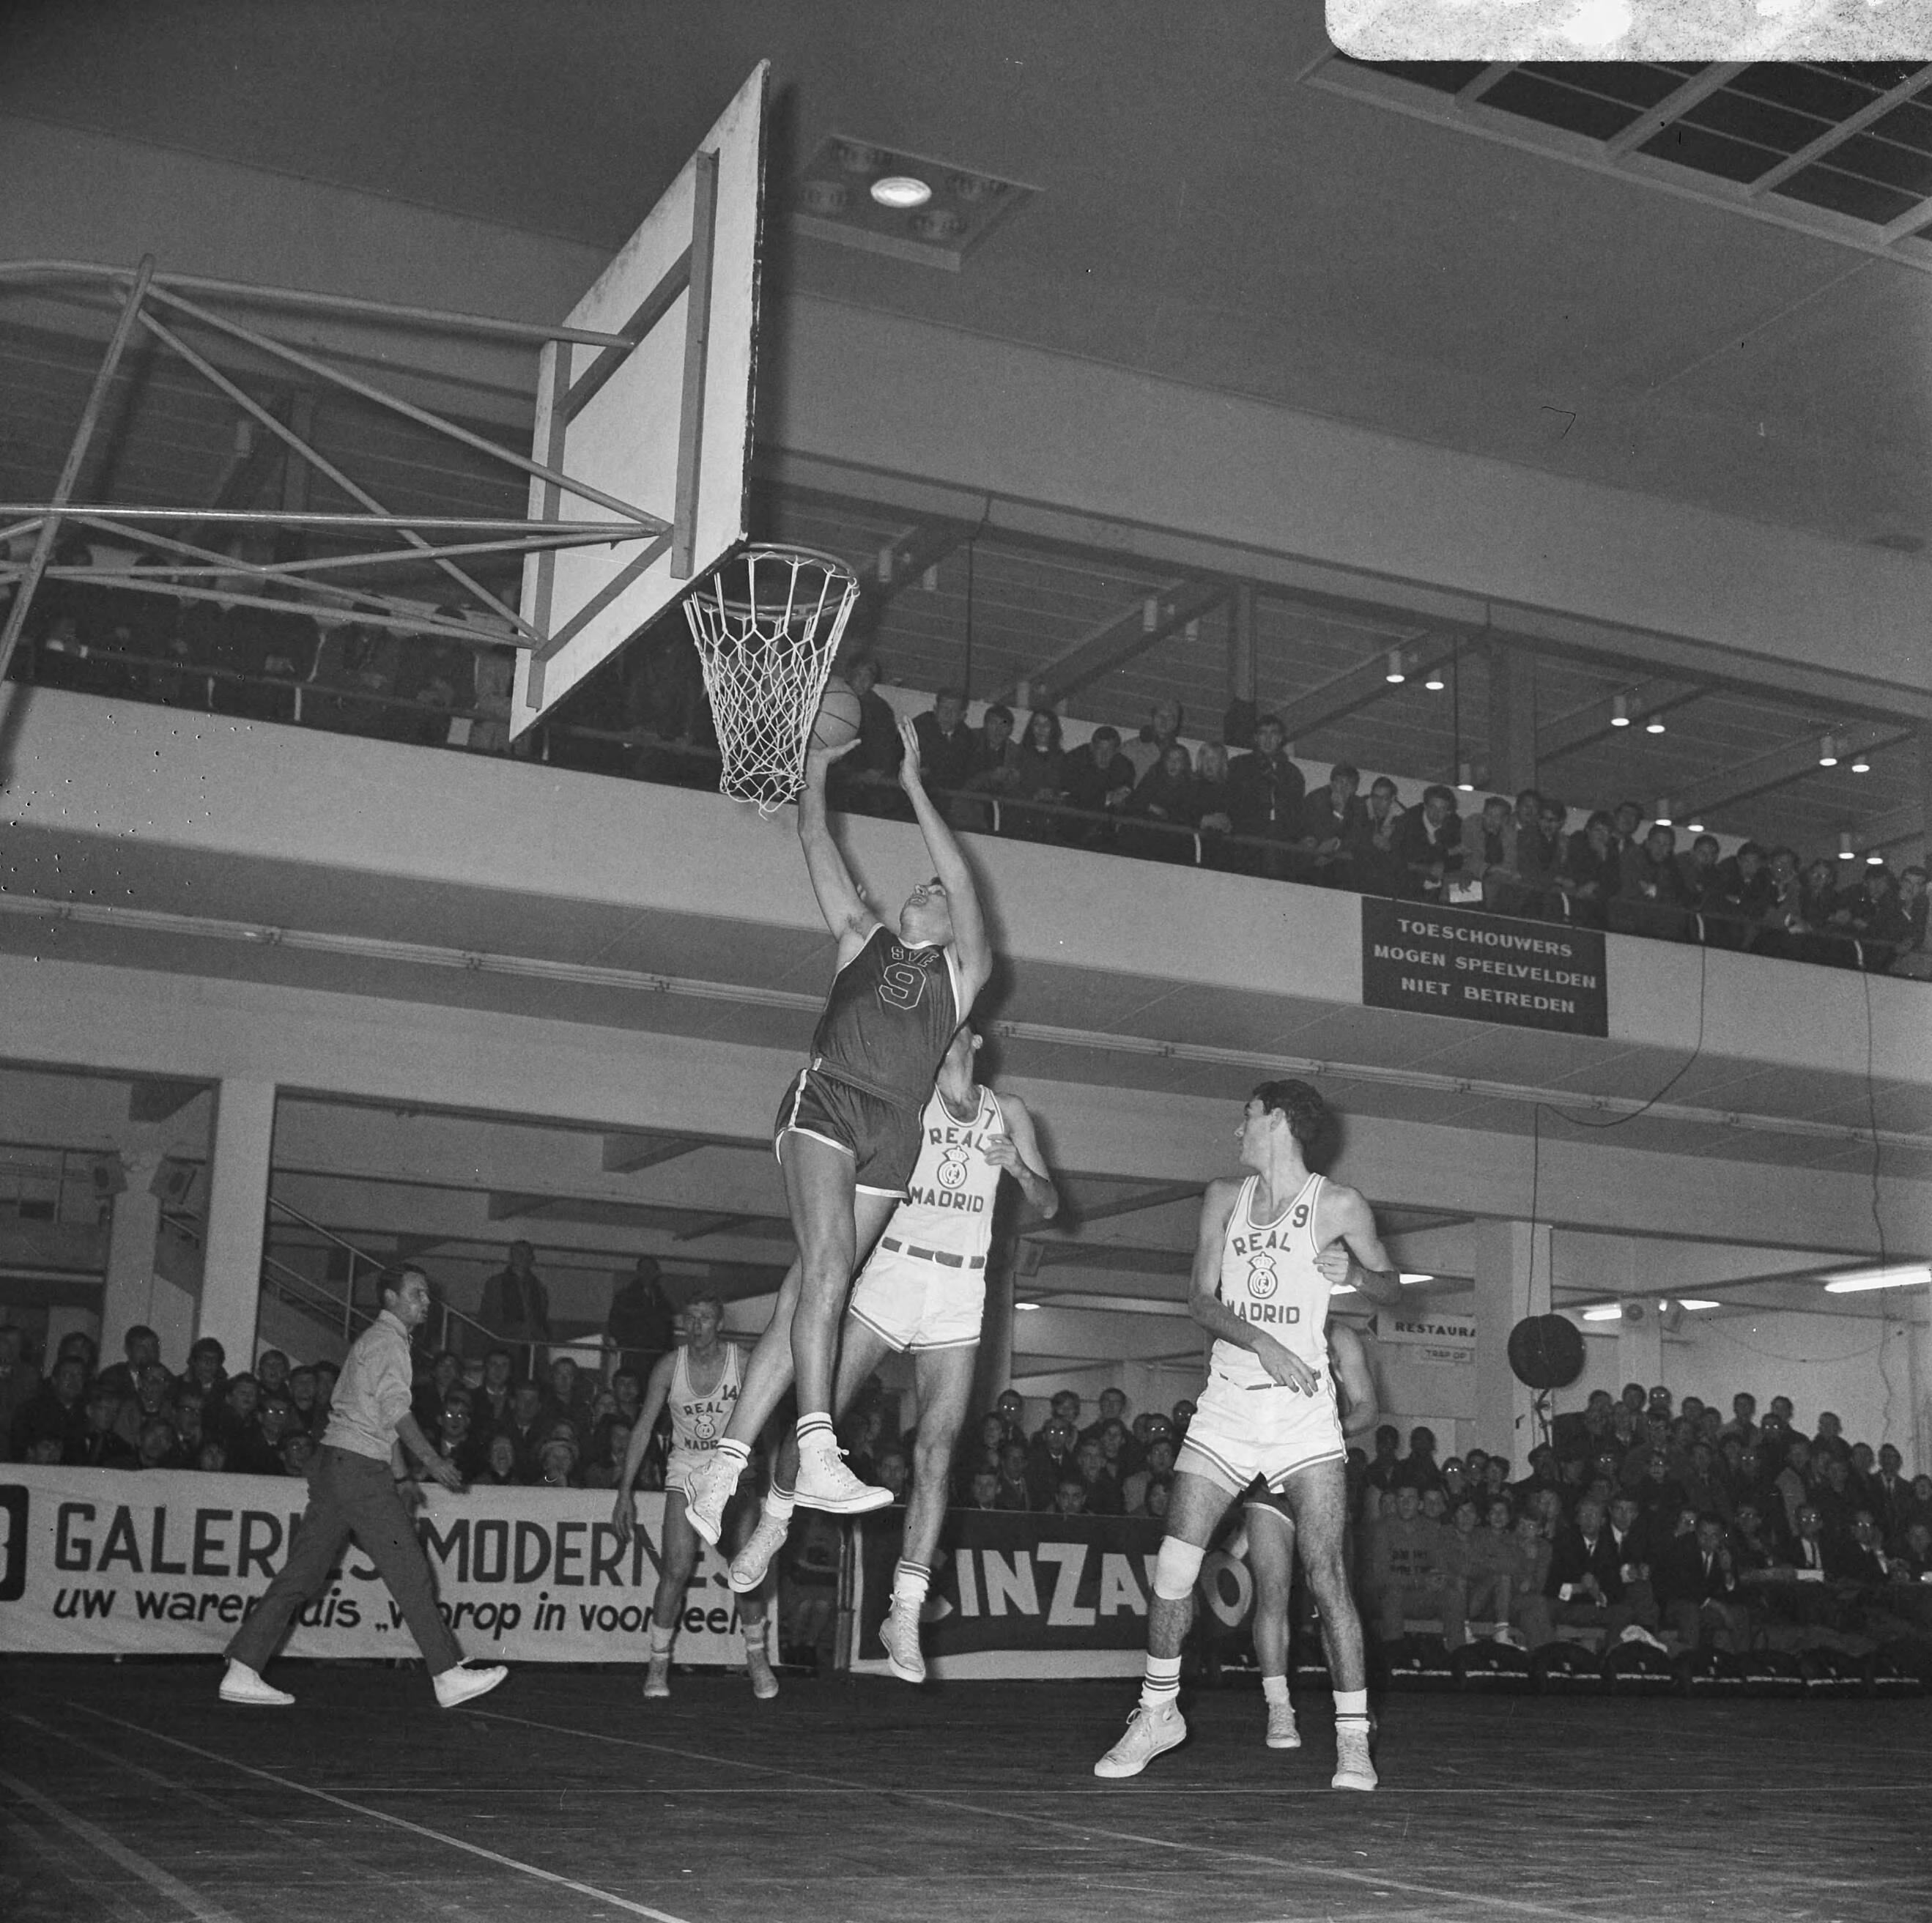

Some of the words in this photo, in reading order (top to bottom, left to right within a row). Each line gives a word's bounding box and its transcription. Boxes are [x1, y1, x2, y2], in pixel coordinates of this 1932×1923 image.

[1397, 919, 1572, 957] TOESCHOUWERS
[1374, 944, 1446, 968] MOGEN
[1454, 956, 1596, 989] SPEELVELDEN
[878, 962, 927, 1010] 9
[1401, 977, 1451, 996] NIET
[1464, 985, 1575, 1014] BETREDEN
[983, 1107, 996, 1130] 7
[928, 1126, 985, 1153] REAL
[911, 1185, 984, 1213] MADRID
[1292, 1204, 1310, 1228] 9
[1231, 1230, 1291, 1256] REAL
[721, 1384, 738, 1401] 14
[683, 1401, 724, 1415] REAL
[684, 1437, 719, 1450] MADR
[418, 1517, 731, 1590] MODERN
[920, 1541, 1254, 1628] INZAO
[53, 1588, 116, 1618] uw
[533, 1591, 566, 1631] in
